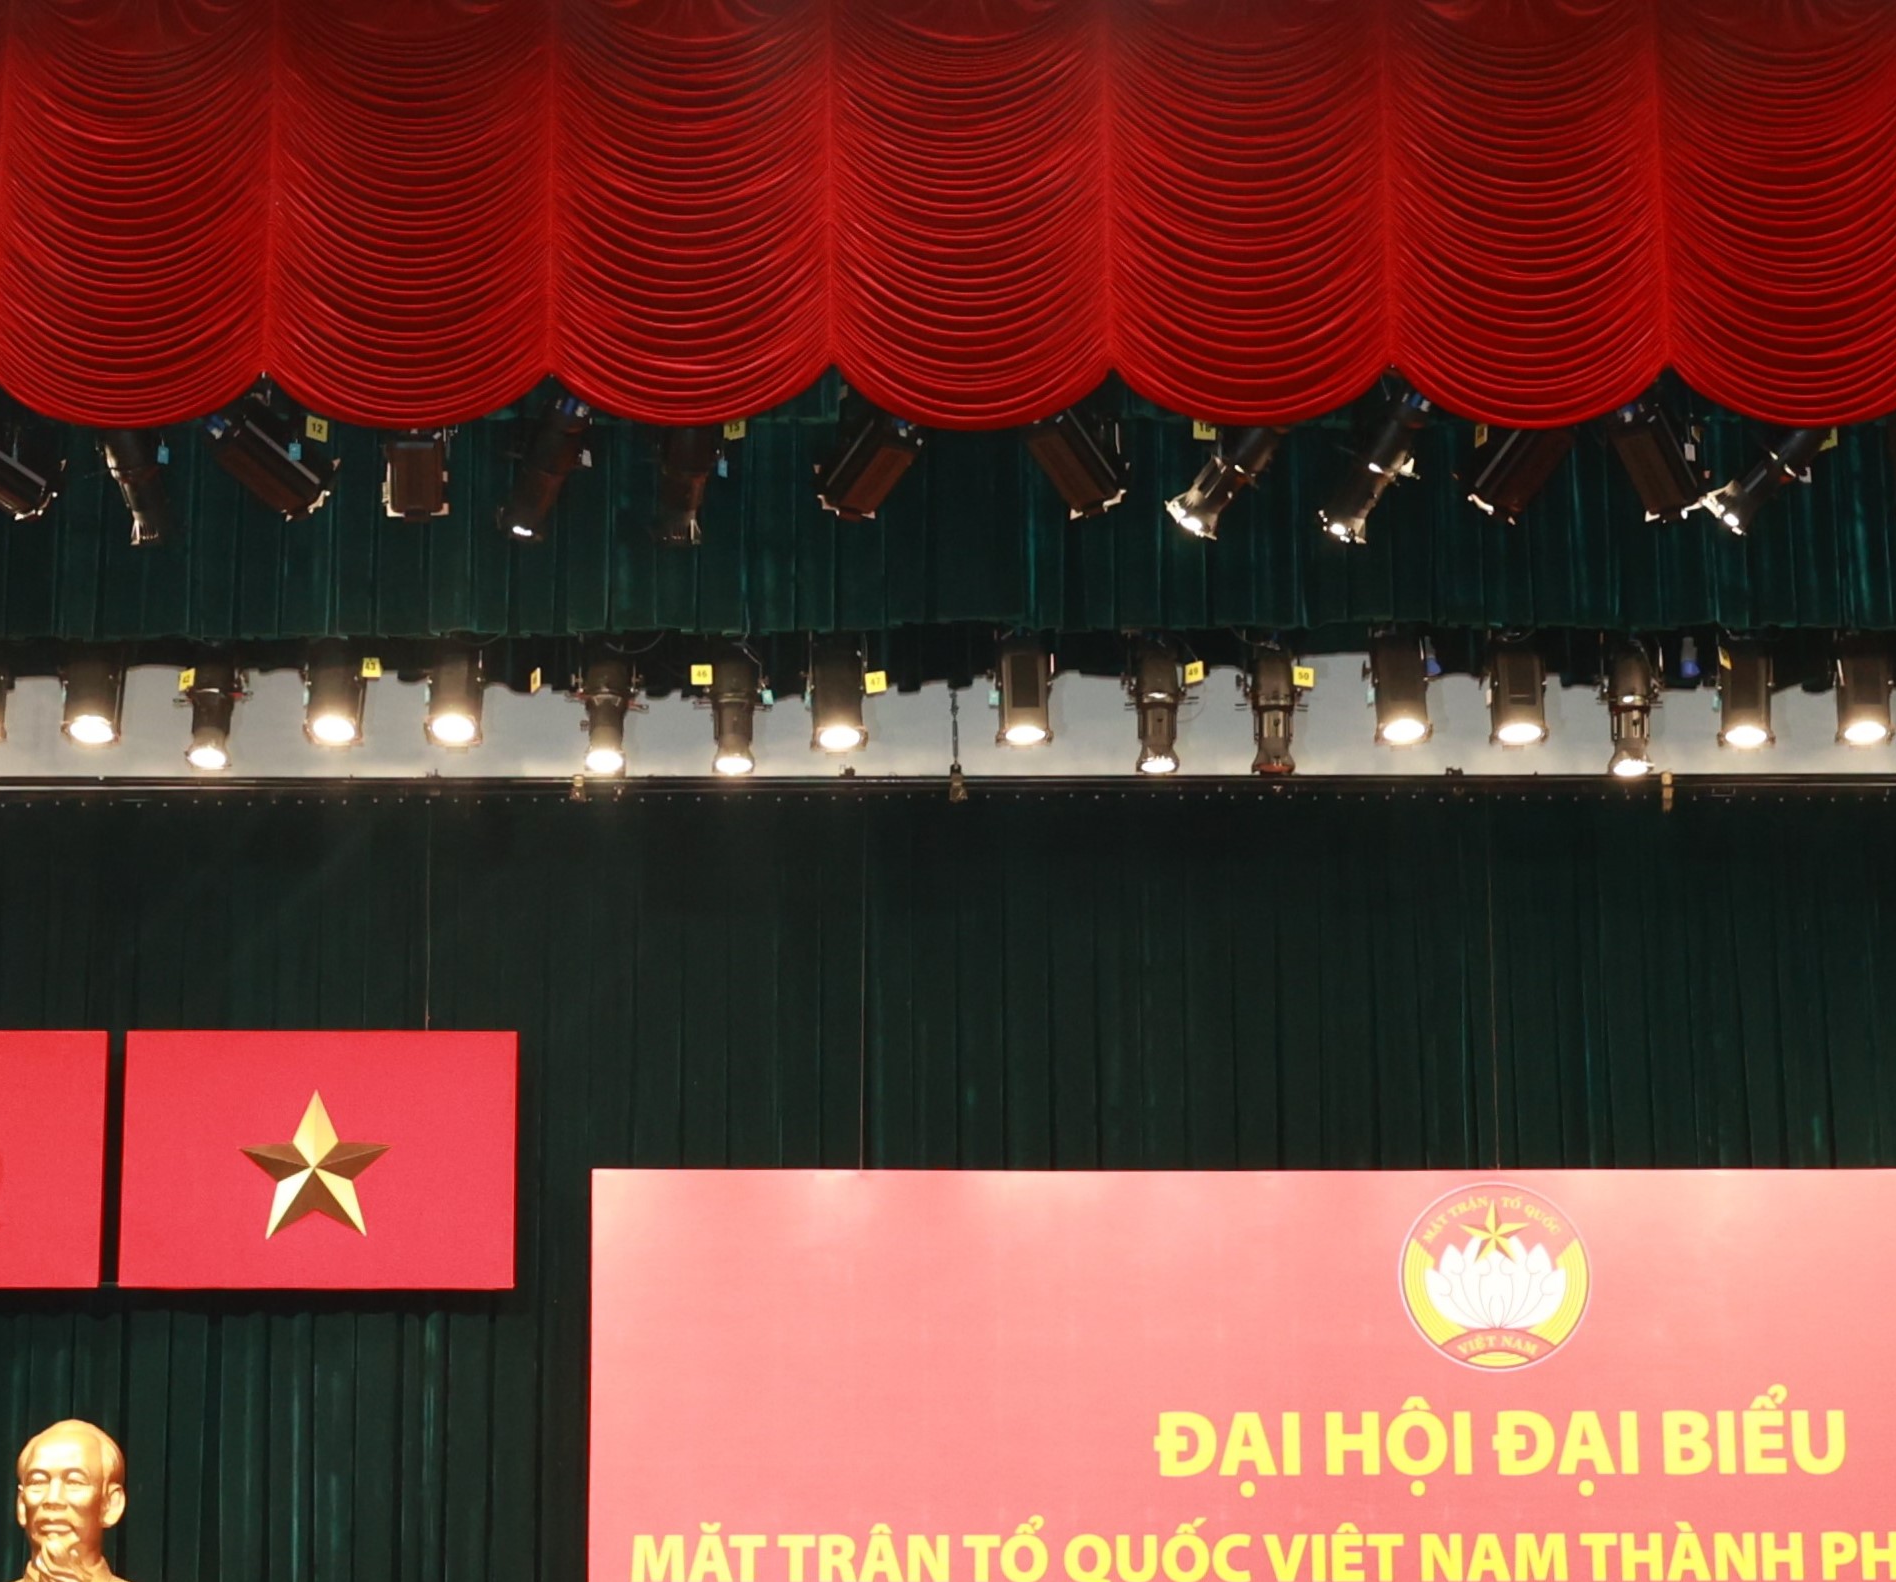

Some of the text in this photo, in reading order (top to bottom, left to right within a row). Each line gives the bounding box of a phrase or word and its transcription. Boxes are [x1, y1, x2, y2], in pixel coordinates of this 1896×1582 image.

[1457, 1334, 1538, 1355] VIỆT NAM
[1153, 1384, 1847, 1496] ĐẠI HỘI ĐẠI BIỂU
[1420, 1532, 1569, 1582] NAM
[1578, 1521, 1805, 1582] THÀNH
